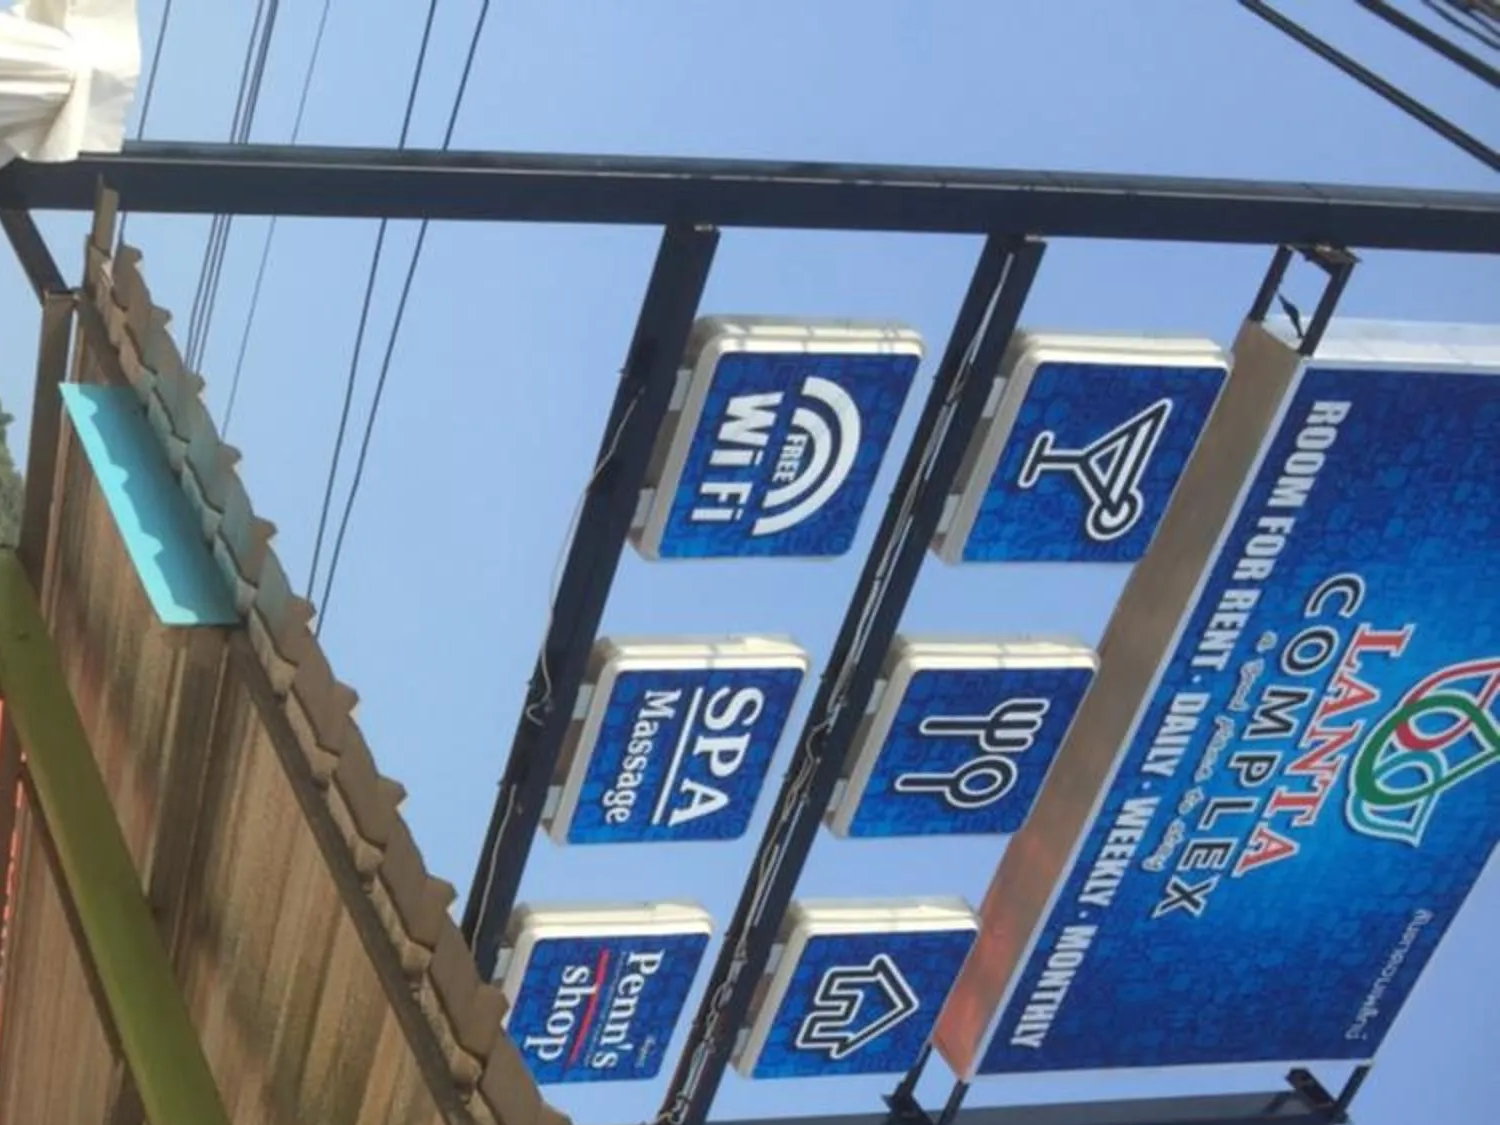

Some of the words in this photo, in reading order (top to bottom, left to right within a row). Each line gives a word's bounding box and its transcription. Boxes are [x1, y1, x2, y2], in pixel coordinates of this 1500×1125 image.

[708, 391, 785, 466] Wi
[771, 432, 808, 483] FREE
[1267, 400, 1352, 507] ROOM
[690, 481, 754, 522] Fi
[1232, 516, 1297, 581] FOR
[1191, 588, 1262, 671] RENT
[1226, 657, 1265, 713] good
[602, 688, 682, 825] Massage
[667, 686, 765, 828] SPA
[1140, 692, 1211, 777] DAILY
[1150, 572, 1367, 919] COMPLEX
[1193, 715, 1236, 783] place
[1231, 622, 1416, 877] LANTA
[1177, 786, 1204, 816] to
[1076, 797, 1160, 907] WEEKLY
[1140, 818, 1187, 873] stay
[523, 964, 600, 1062] shop
[590, 948, 666, 1069] Penn's
[1009, 925, 1099, 1048] MONTHLY
